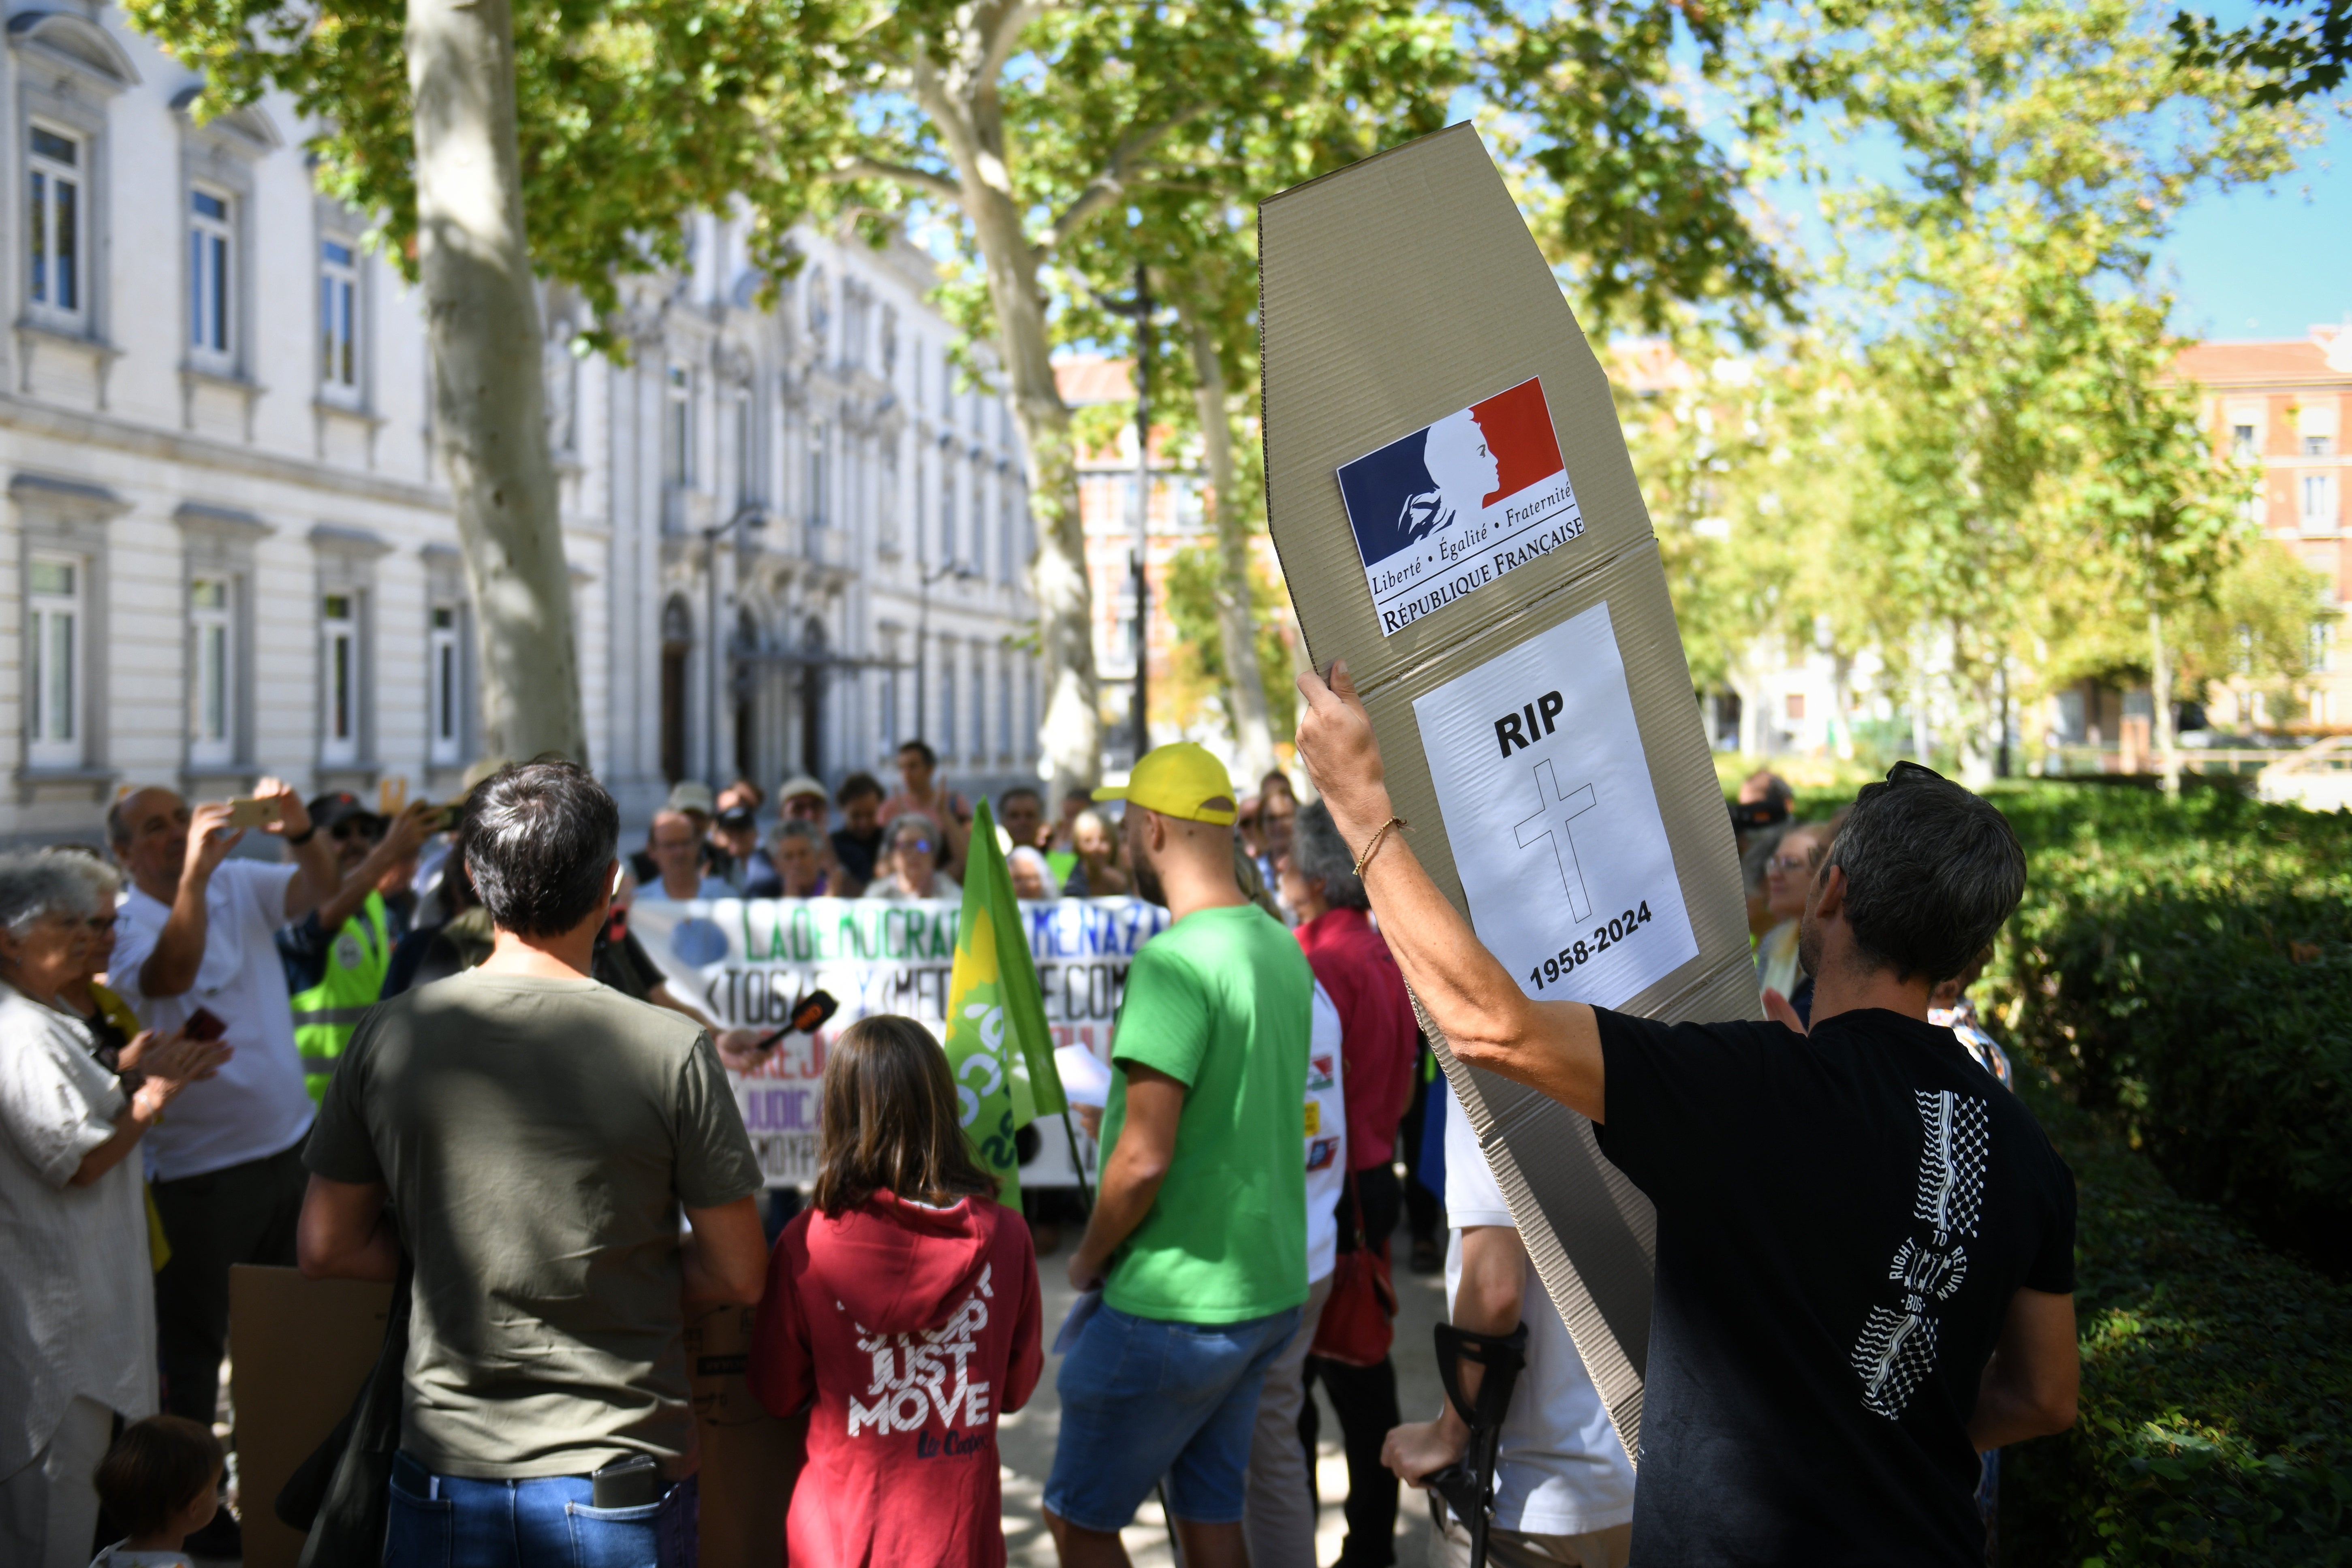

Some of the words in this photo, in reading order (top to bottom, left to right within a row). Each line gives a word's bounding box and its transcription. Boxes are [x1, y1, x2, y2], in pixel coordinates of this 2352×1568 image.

[1371, 556, 1421, 596] Liberté
[1439, 523, 1488, 561] Égalité
[1505, 481, 1571, 528] Fraternité
[1382, 564, 1491, 634] RÉPUBLIQUE
[1493, 517, 1585, 575] FRANÇAISE
[1494, 690, 1564, 759] RIP
[1530, 899, 1652, 991] 1958-2024
[1888, 1236, 1916, 1280] RIGHT
[1931, 1230, 1948, 1247] TO
[1936, 1245, 1967, 1301] RETURN
[867, 1341, 977, 1395] JUST
[848, 1381, 990, 1437] MOVE
